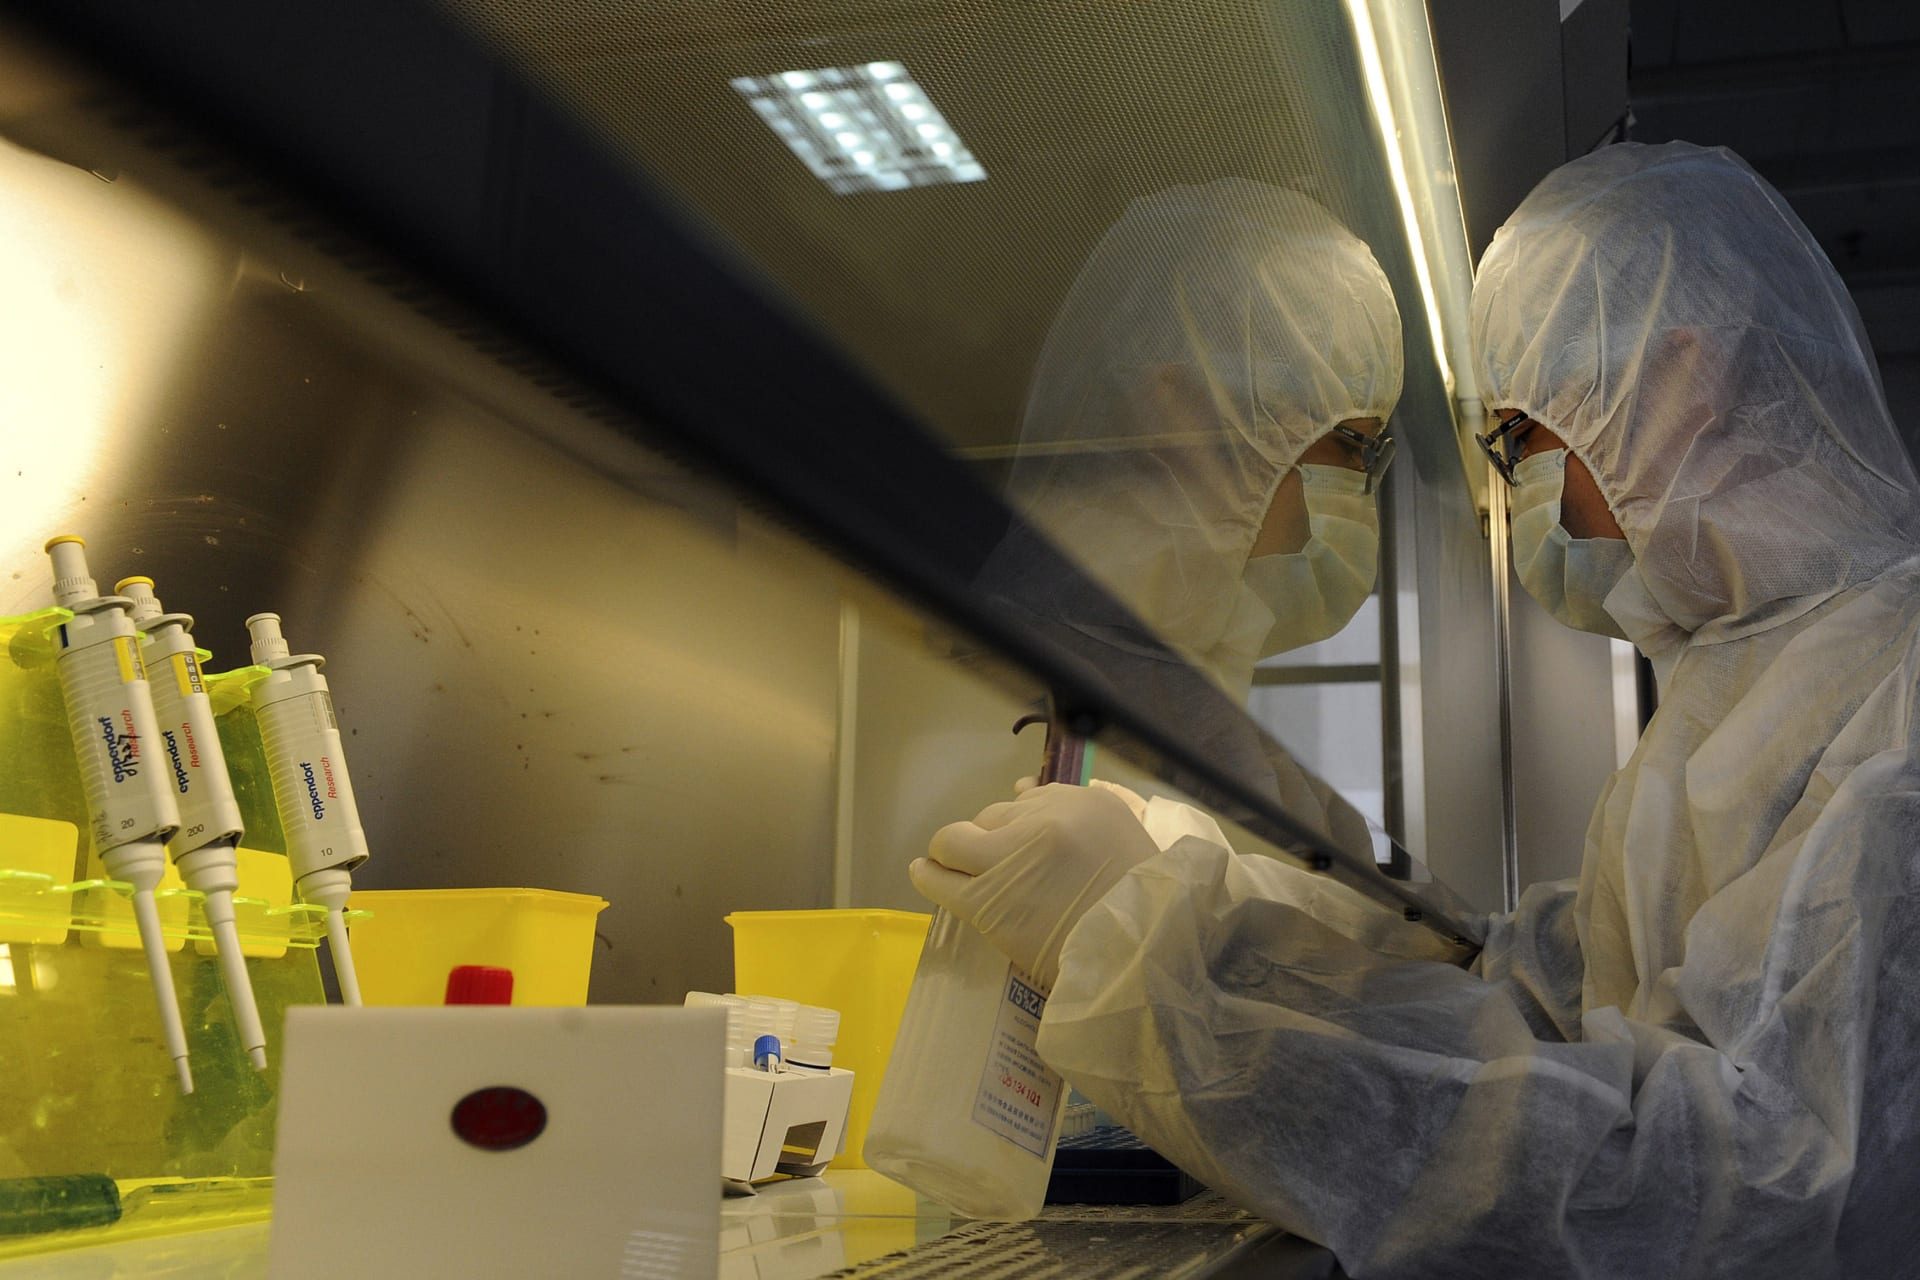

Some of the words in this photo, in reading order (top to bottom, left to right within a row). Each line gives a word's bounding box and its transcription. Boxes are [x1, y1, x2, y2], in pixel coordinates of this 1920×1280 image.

[97, 716, 124, 784] eppendorf
[162, 730, 188, 794] eppendorf
[180, 722, 201, 769] Research
[303, 761, 325, 821] eppendorf
[320, 756, 338, 800] Research
[120, 817, 135, 830] 20
[187, 823, 205, 838] 200
[320, 846, 334, 857] 10
